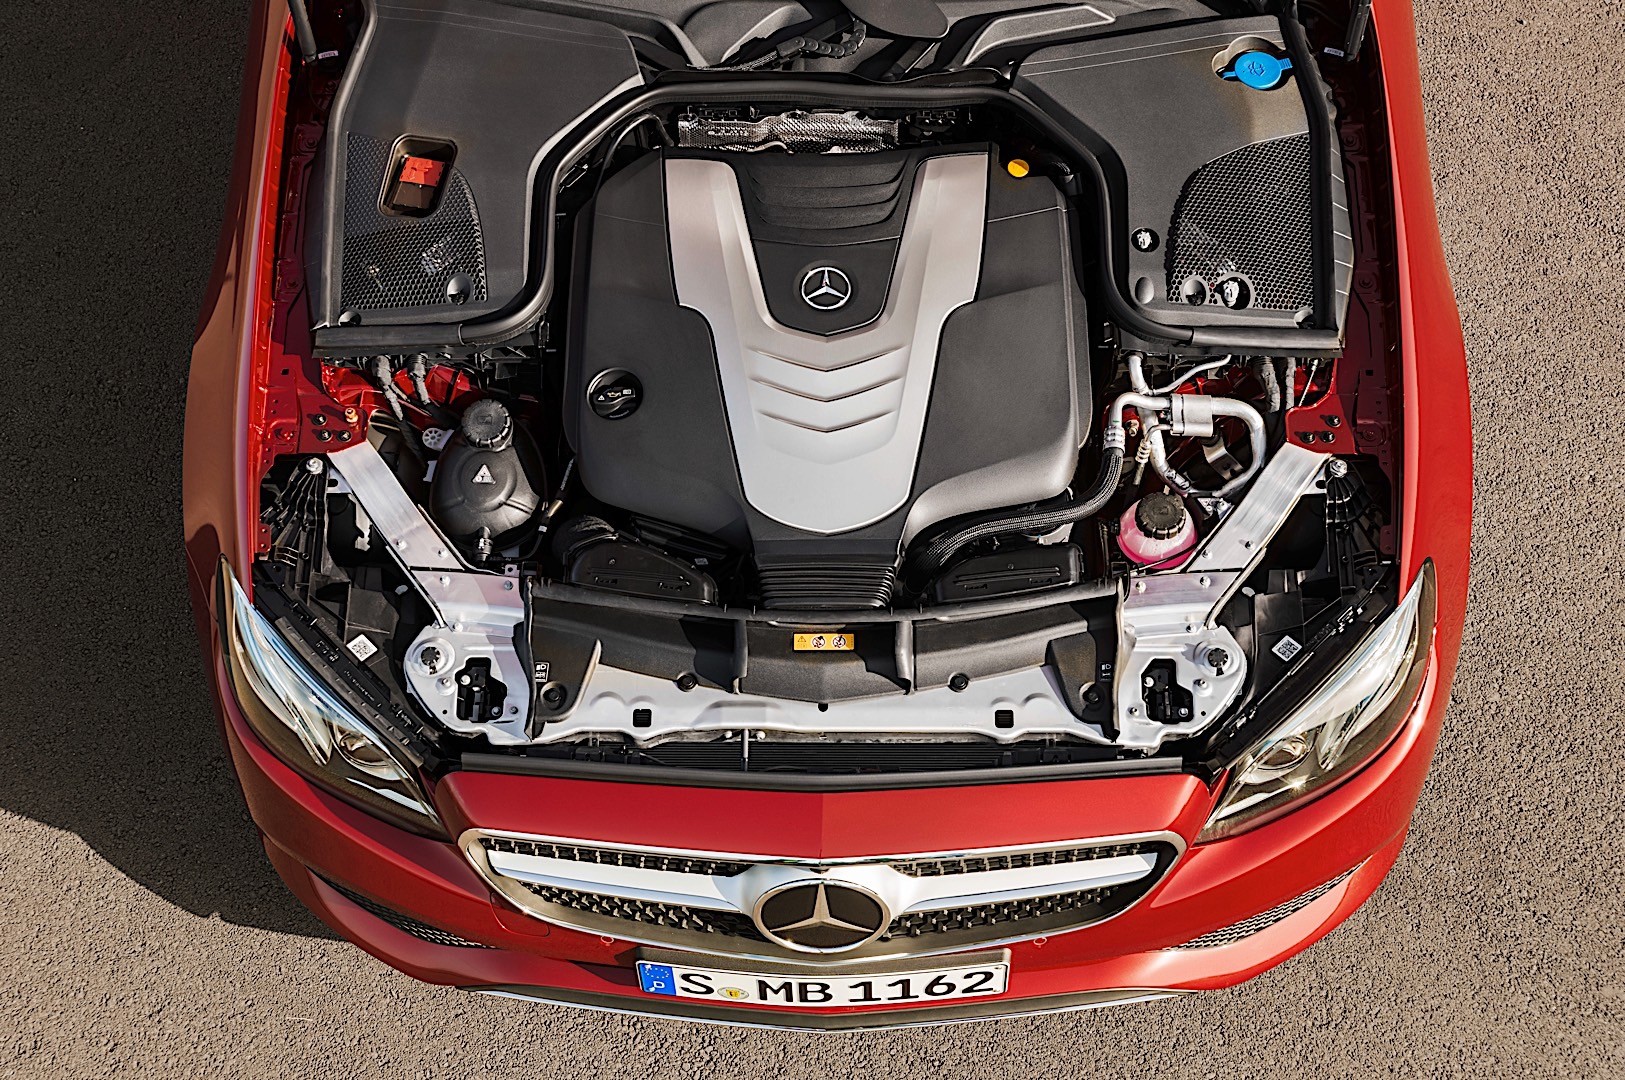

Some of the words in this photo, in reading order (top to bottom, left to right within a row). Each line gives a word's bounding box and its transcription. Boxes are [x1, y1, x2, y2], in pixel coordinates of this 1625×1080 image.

[653, 980, 665, 989] D
[680, 973, 715, 995] S
[757, 979, 834, 1003] MB
[848, 971, 995, 1003] 1162
